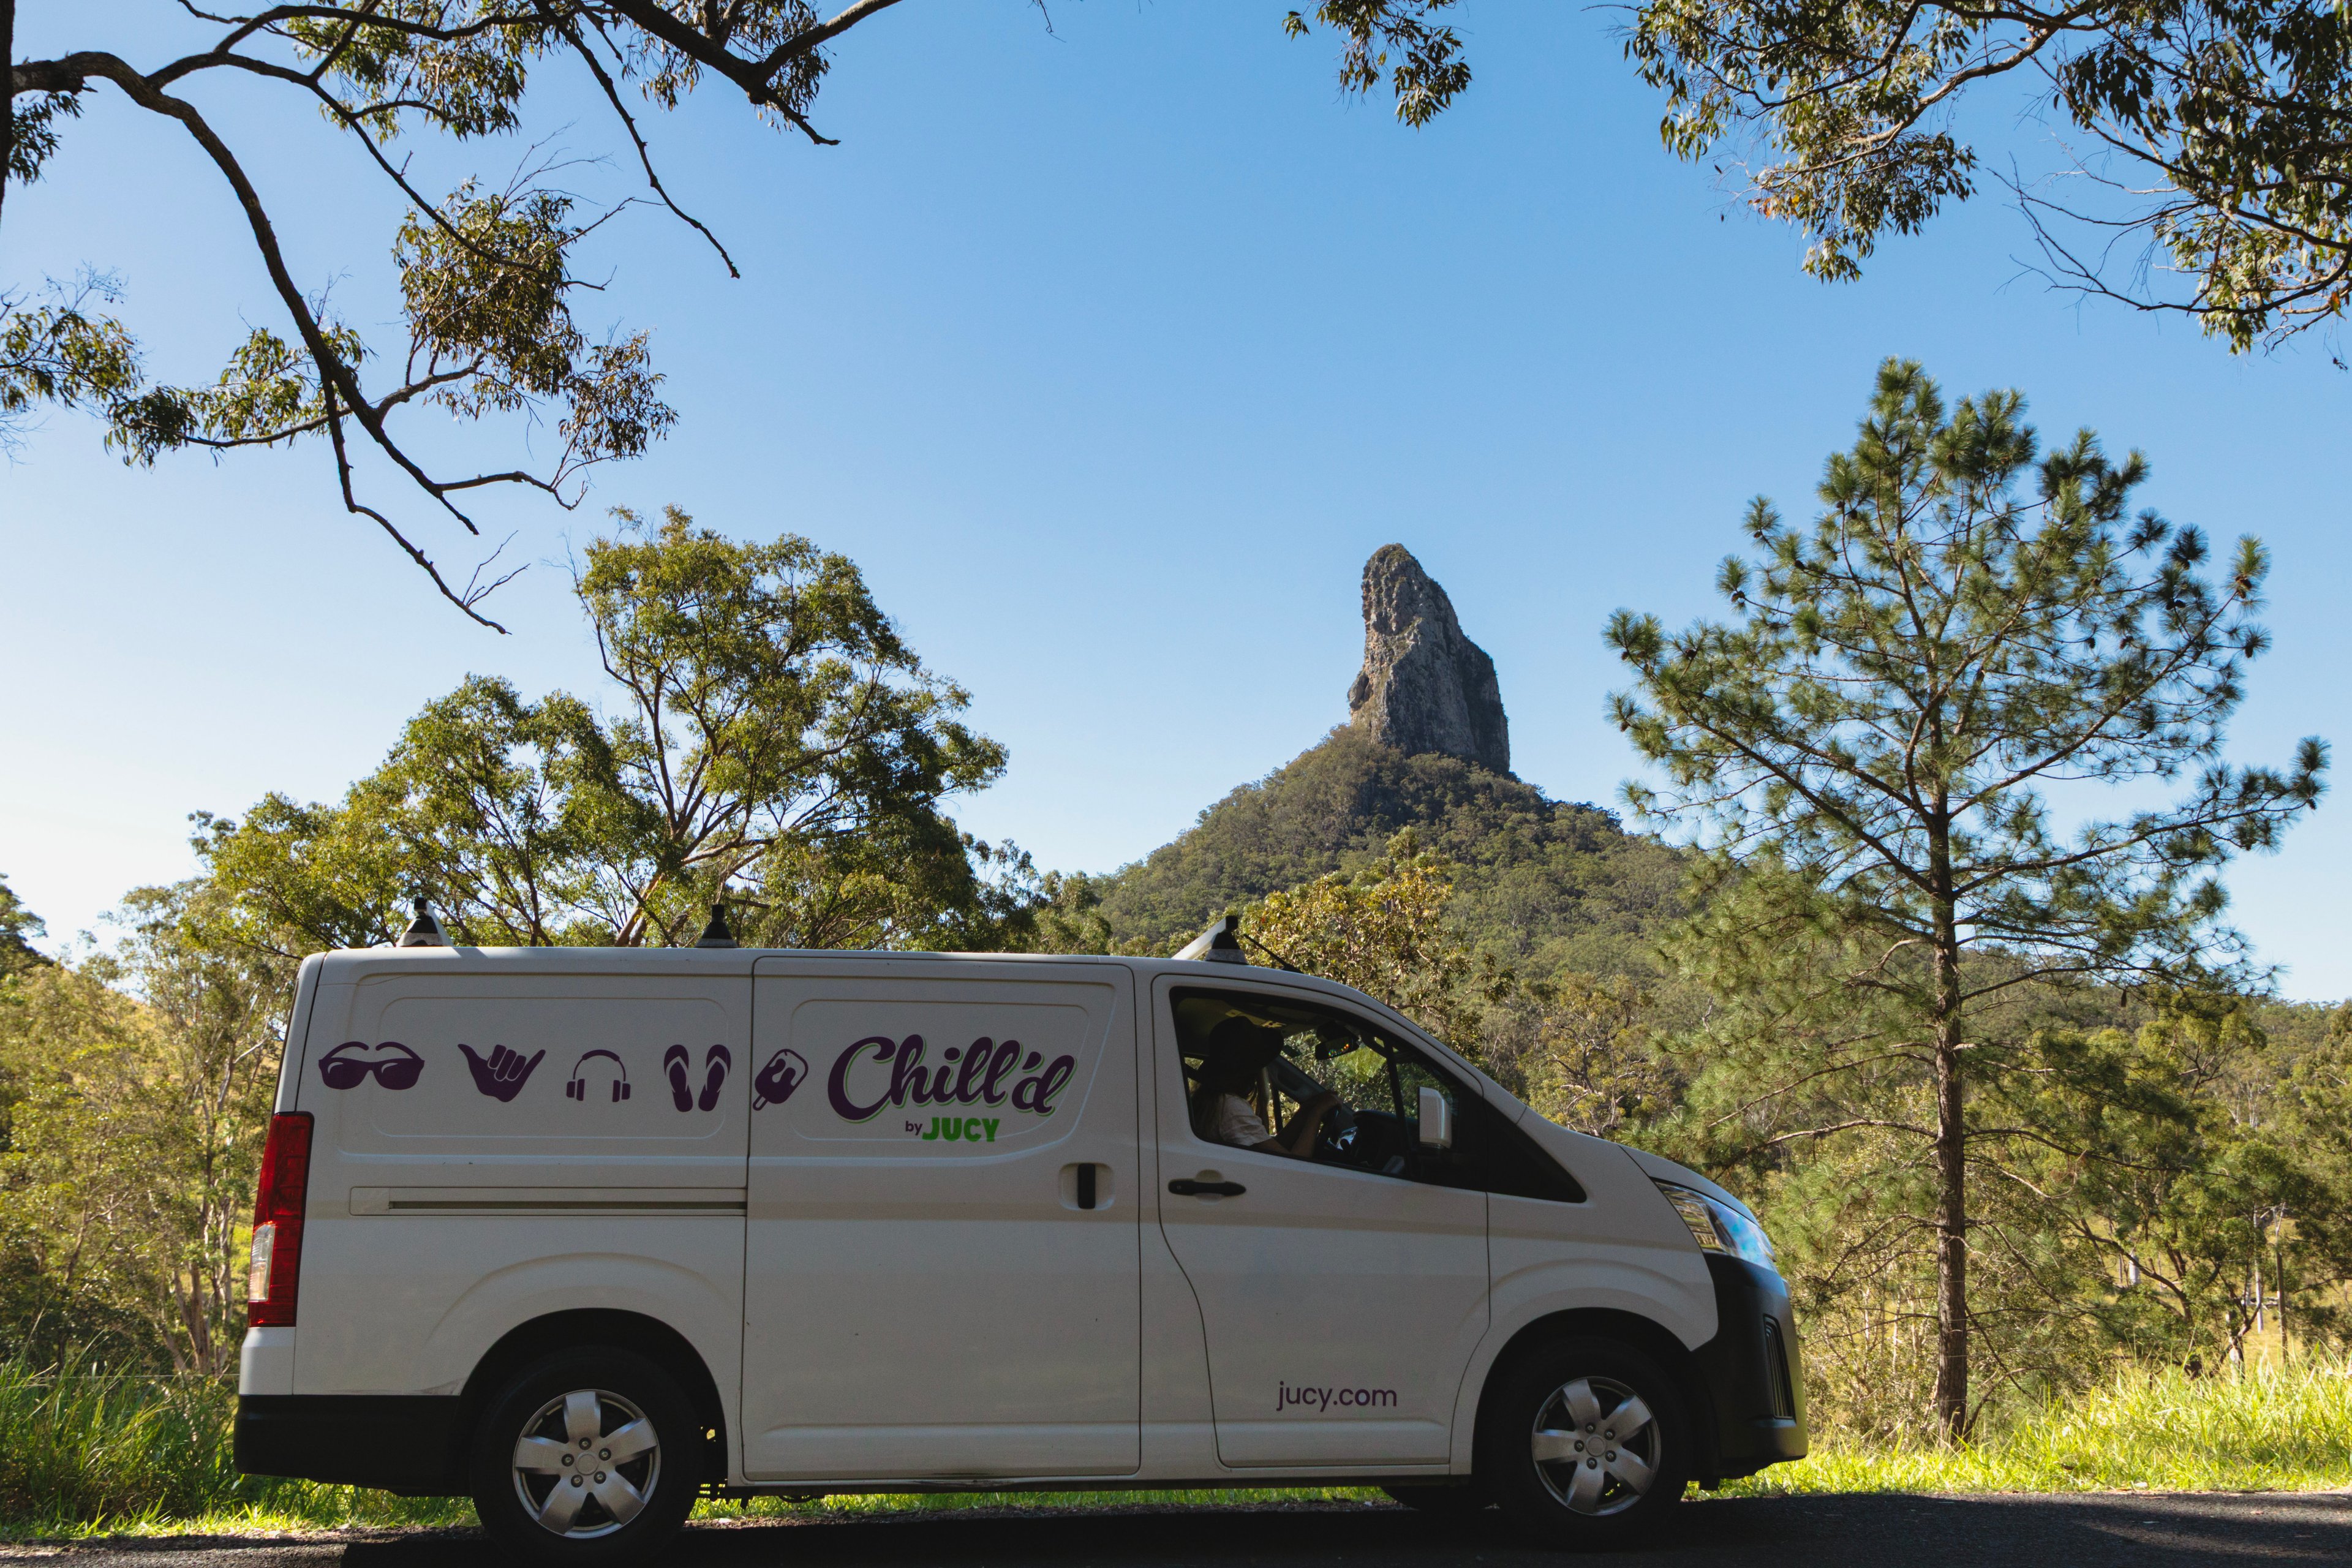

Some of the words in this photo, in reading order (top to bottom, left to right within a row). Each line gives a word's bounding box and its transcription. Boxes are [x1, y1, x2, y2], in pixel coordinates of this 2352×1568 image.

[827, 1034, 1077, 1123] Chill'd
[905, 1120, 923, 1136] by
[922, 1117, 1000, 1142] JUCY
[1276, 1381, 1397, 1412] jucy.com
